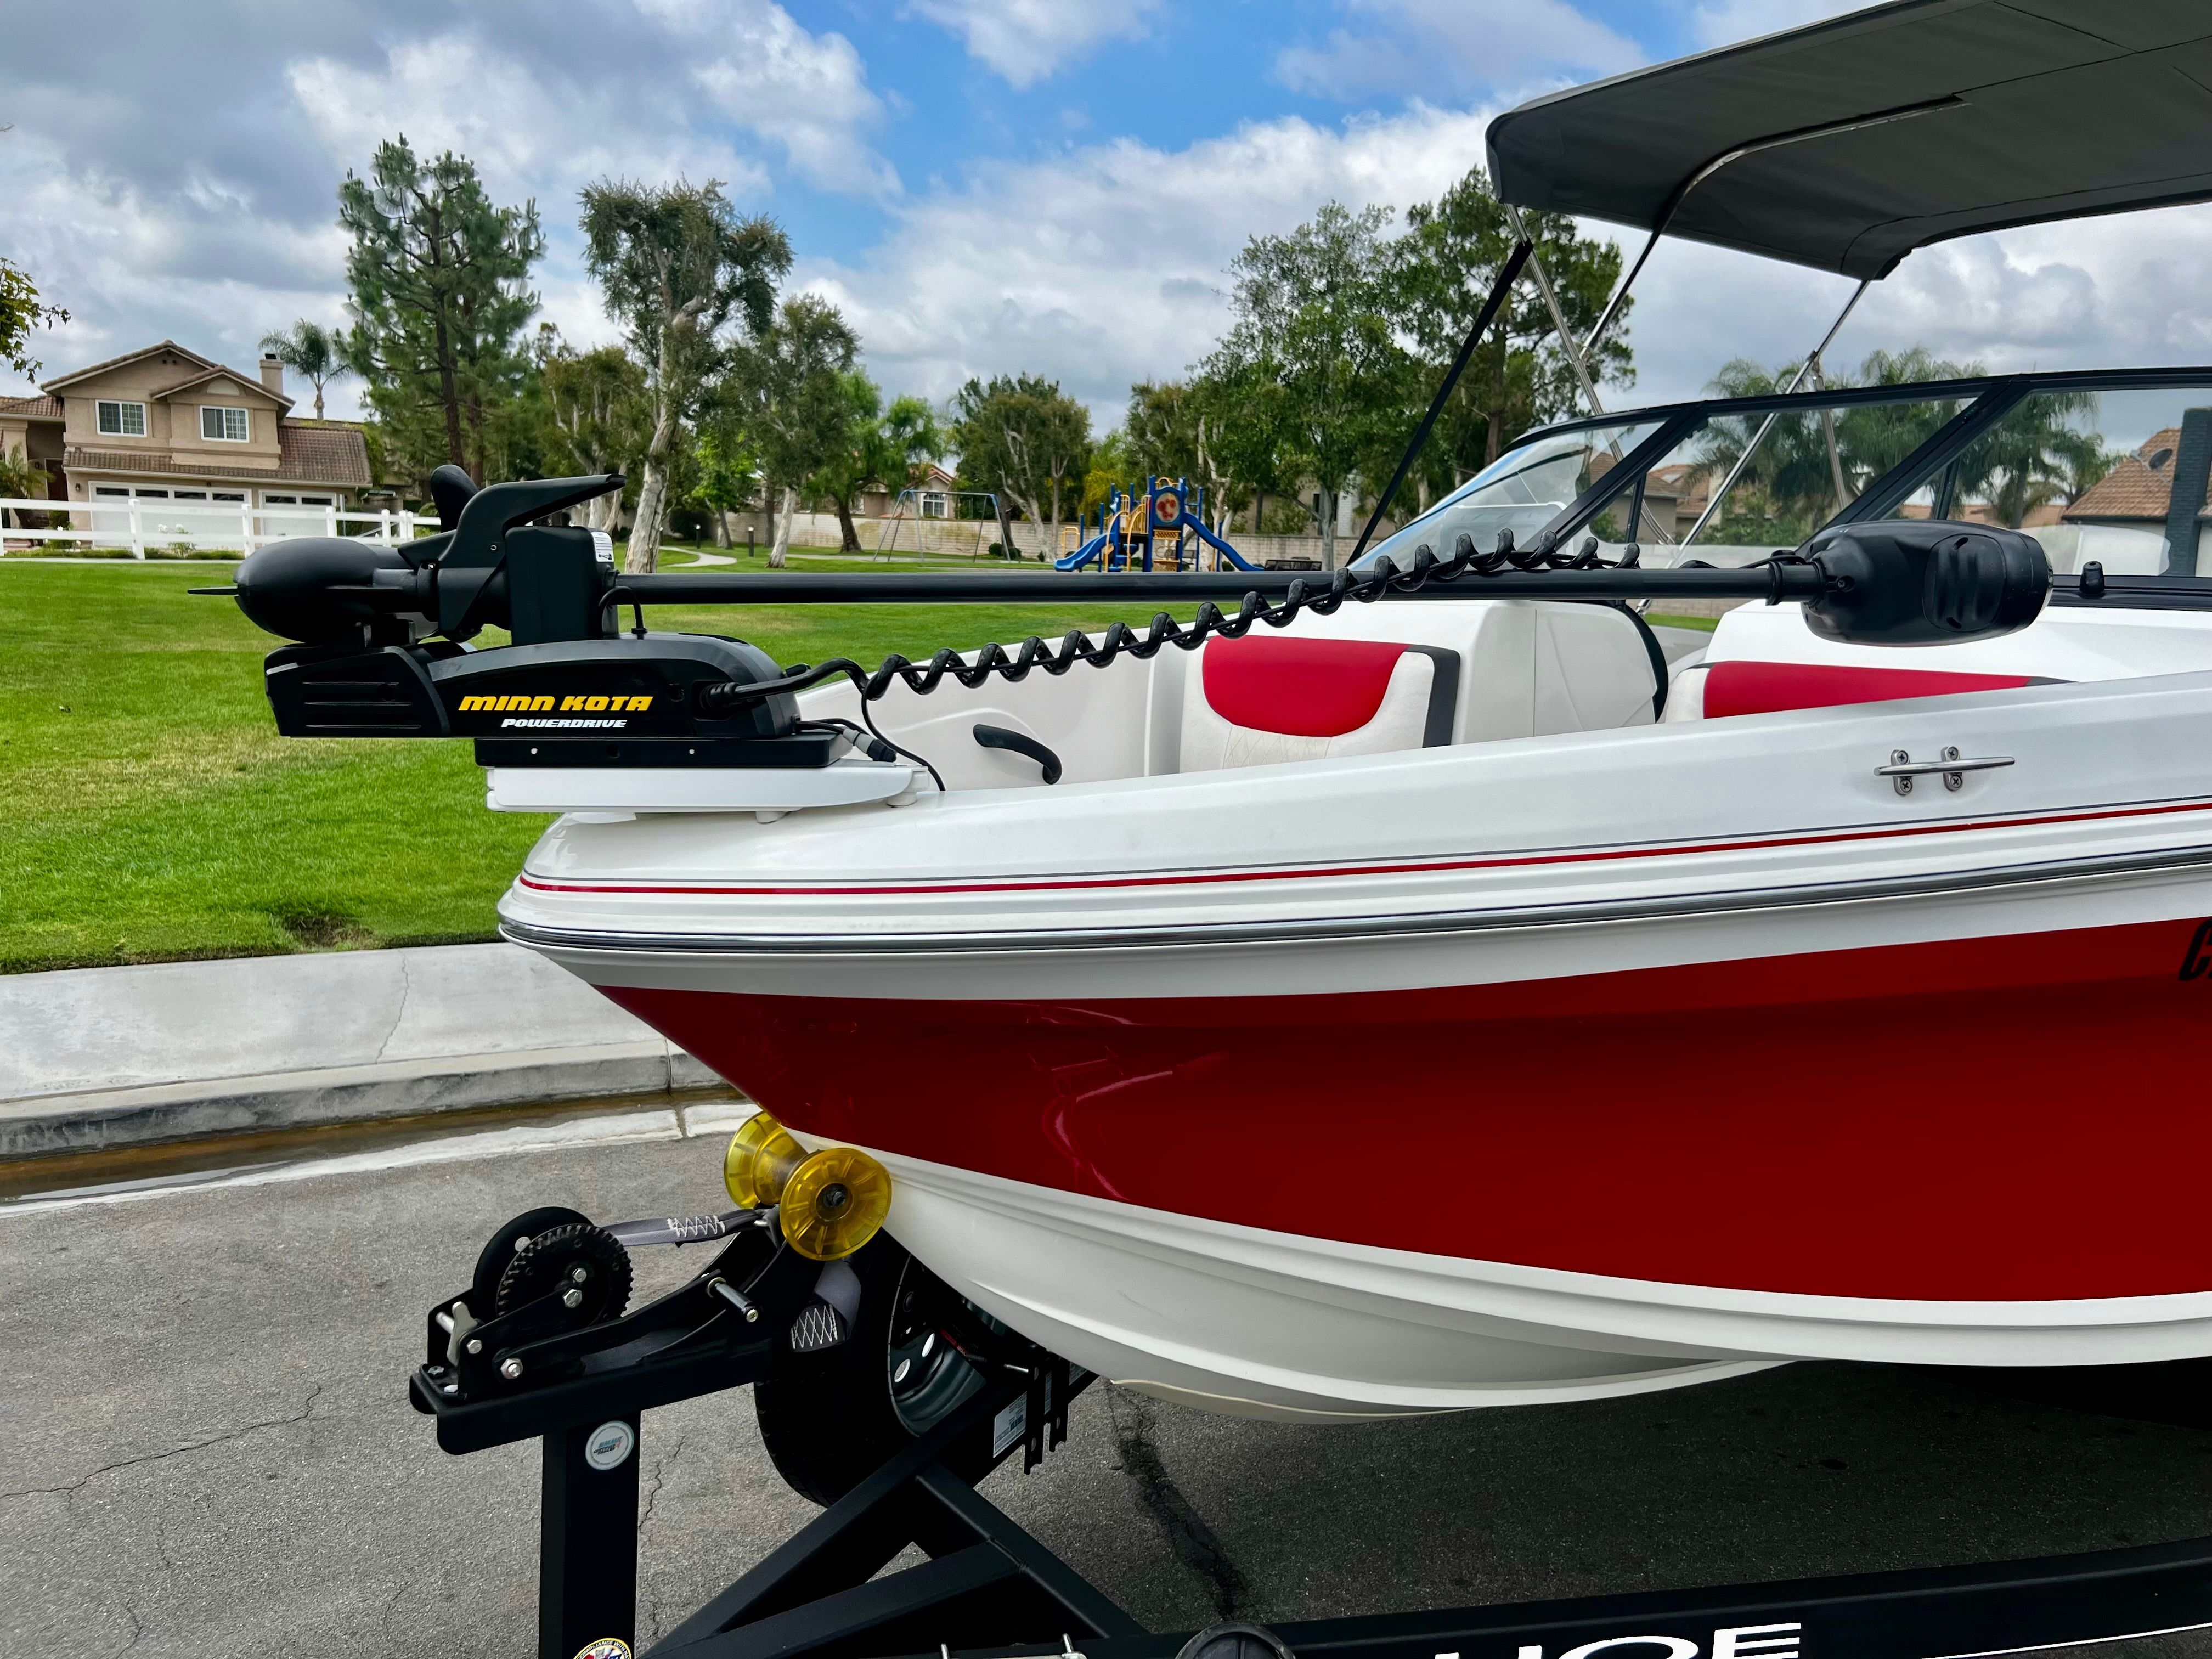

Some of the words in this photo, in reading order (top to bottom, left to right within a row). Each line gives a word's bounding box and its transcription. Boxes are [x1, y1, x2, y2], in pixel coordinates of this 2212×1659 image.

[458, 696, 556, 711] MINN
[560, 696, 653, 711] KOTA
[501, 719, 627, 728] POWERDRIVE
